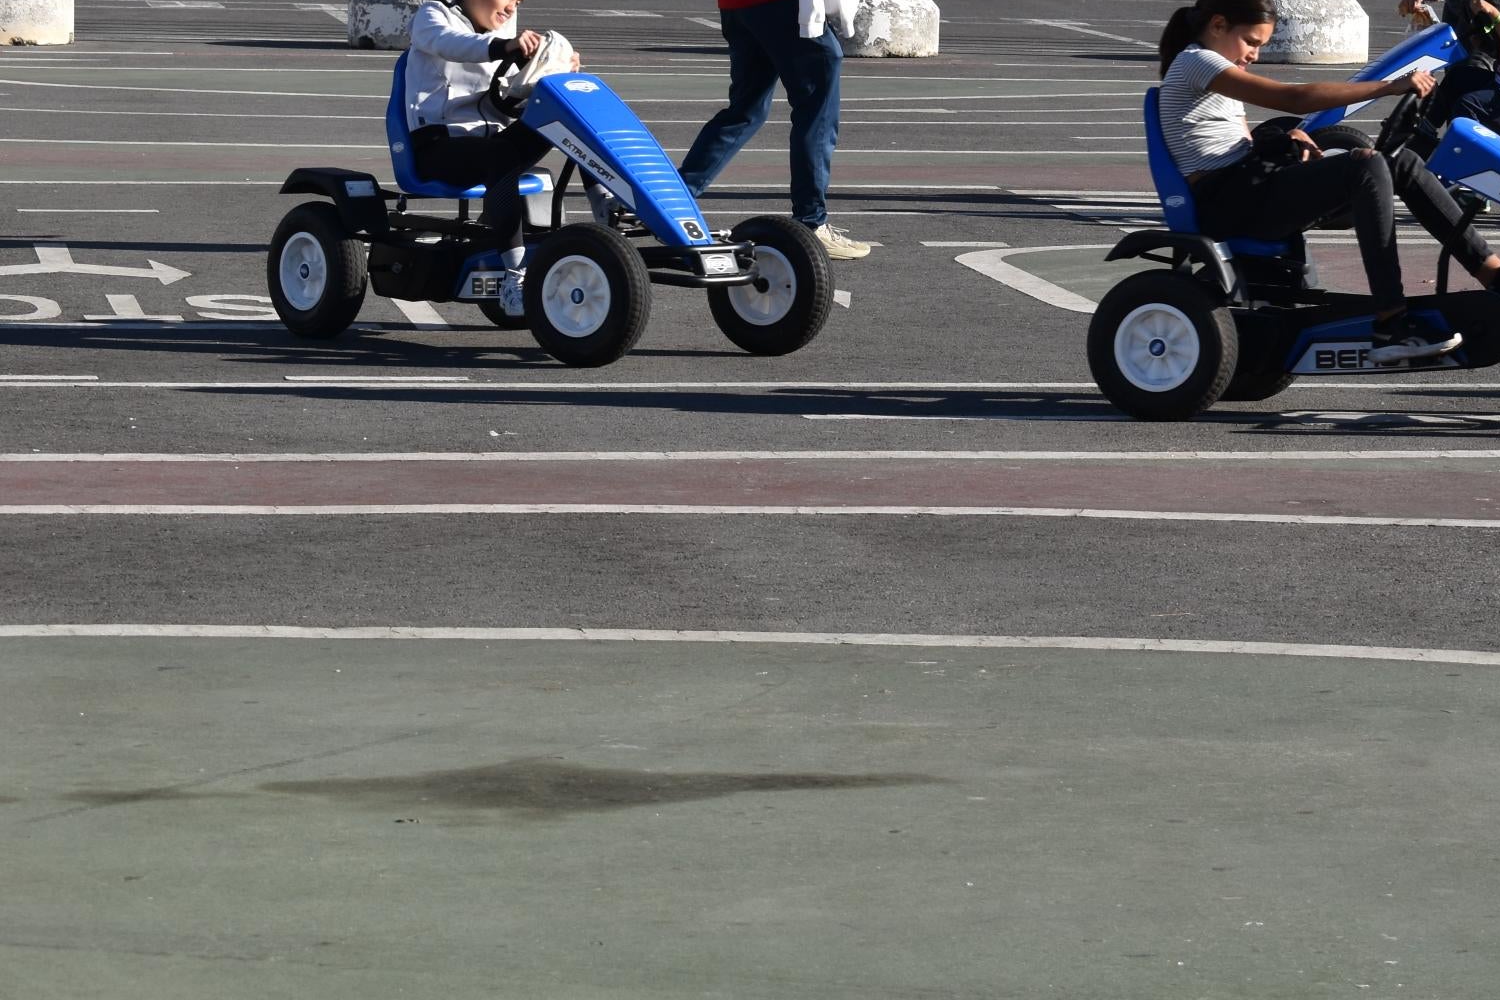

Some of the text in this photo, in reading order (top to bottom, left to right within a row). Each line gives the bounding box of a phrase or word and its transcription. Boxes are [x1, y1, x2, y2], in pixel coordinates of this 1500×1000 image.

[561, 138, 616, 182] EXTRA SPORT
[683, 221, 704, 240] 8
